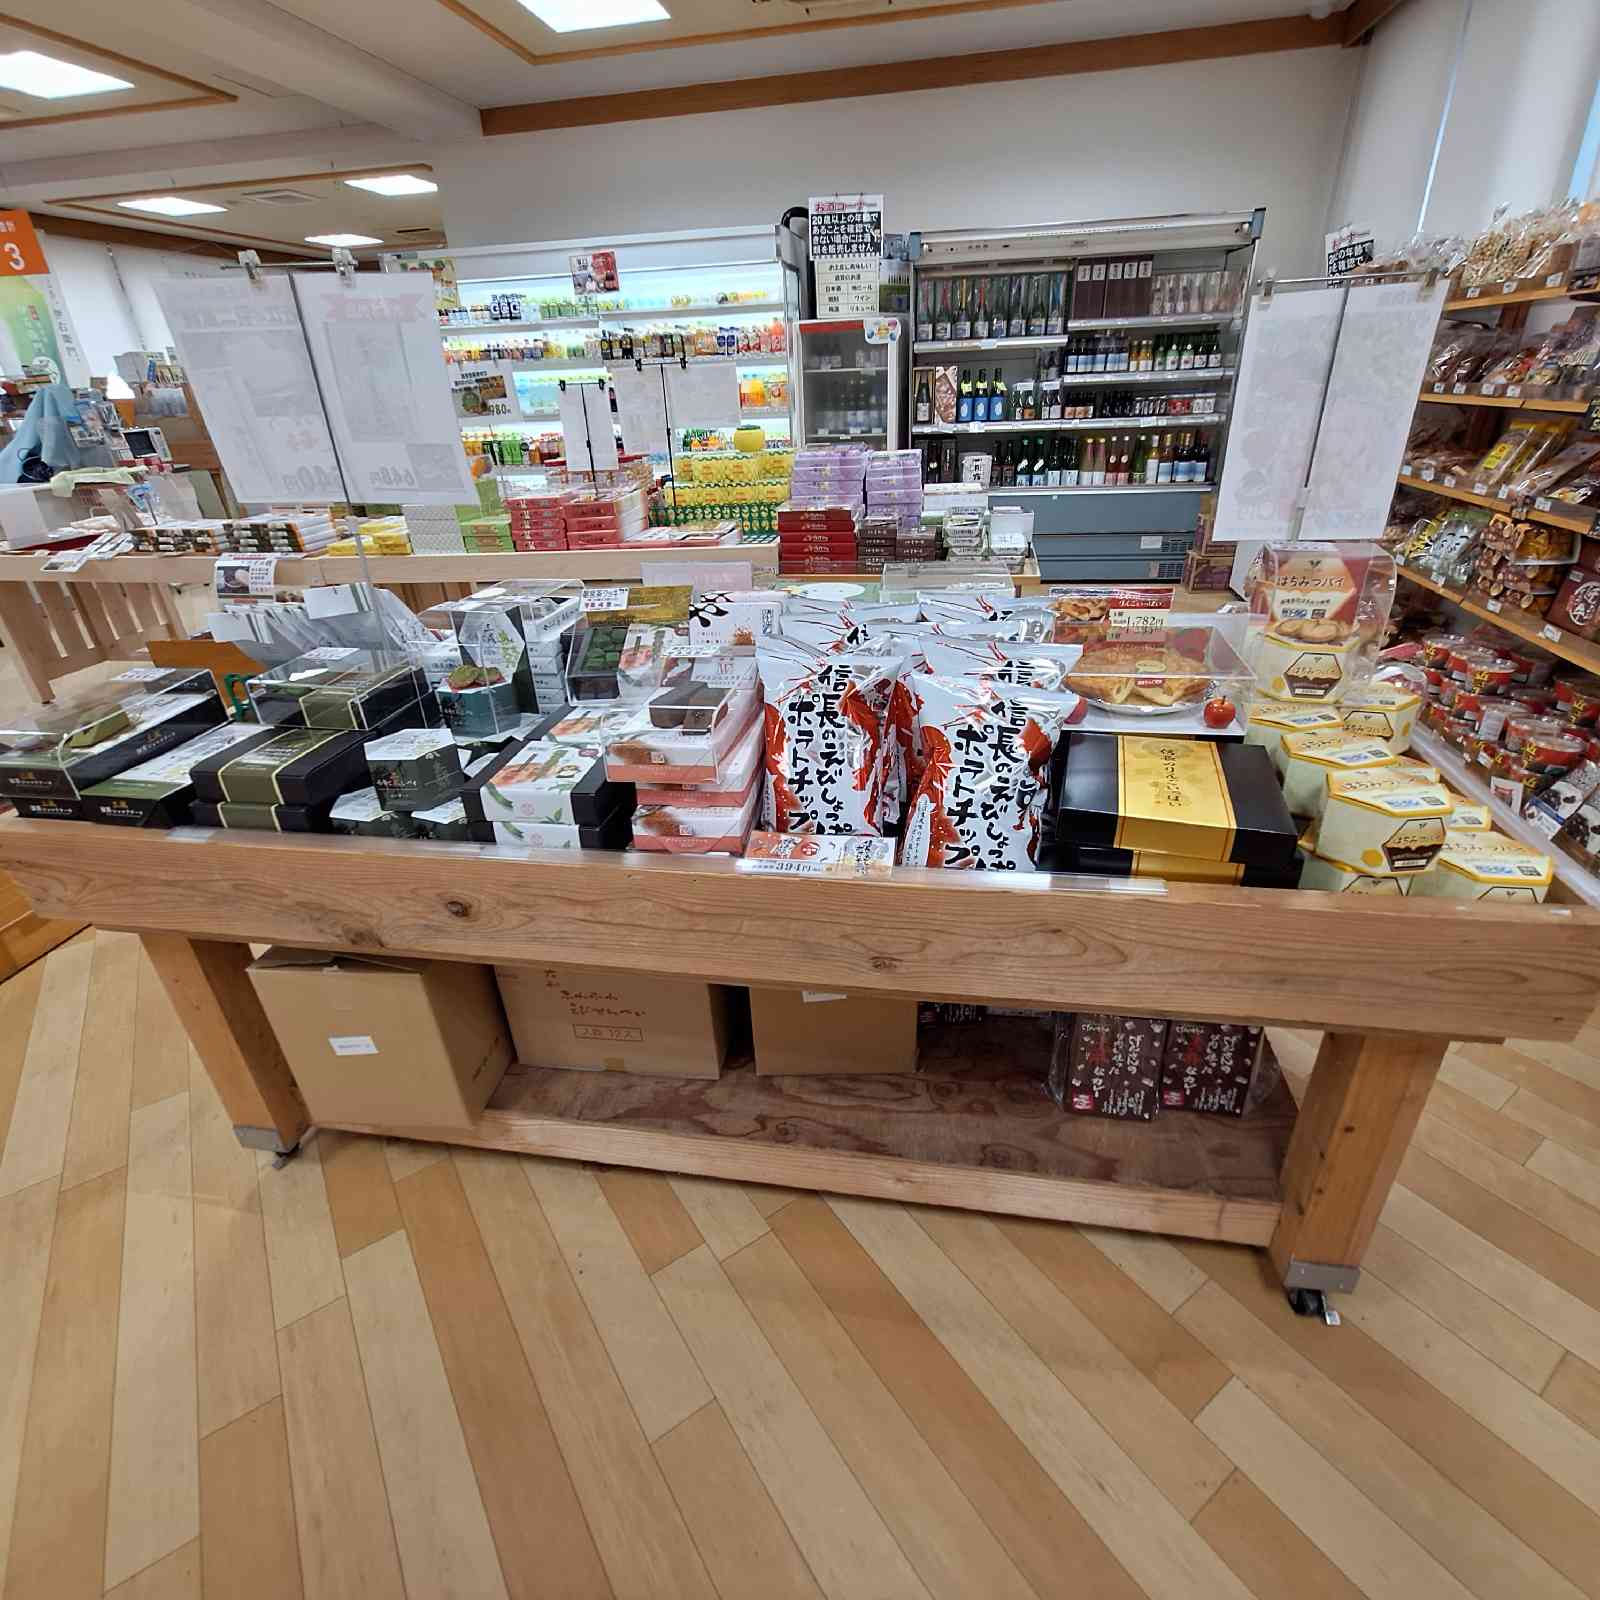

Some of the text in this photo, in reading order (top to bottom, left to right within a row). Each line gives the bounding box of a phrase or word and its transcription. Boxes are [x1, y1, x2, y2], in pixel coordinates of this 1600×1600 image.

[812, 213, 878, 225] 20歳以上の年齢で
[812, 223, 871, 235] あることを確認で
[812, 243, 874, 255] 類を販売しません
[4, 242, 25, 271] 3
[1280, 575, 1345, 587] はちみつパイ
[1127, 616, 1164, 626] 1,782円
[787, 692, 820, 831] ポテトチップ
[945, 724, 995, 866] ポテトチップ
